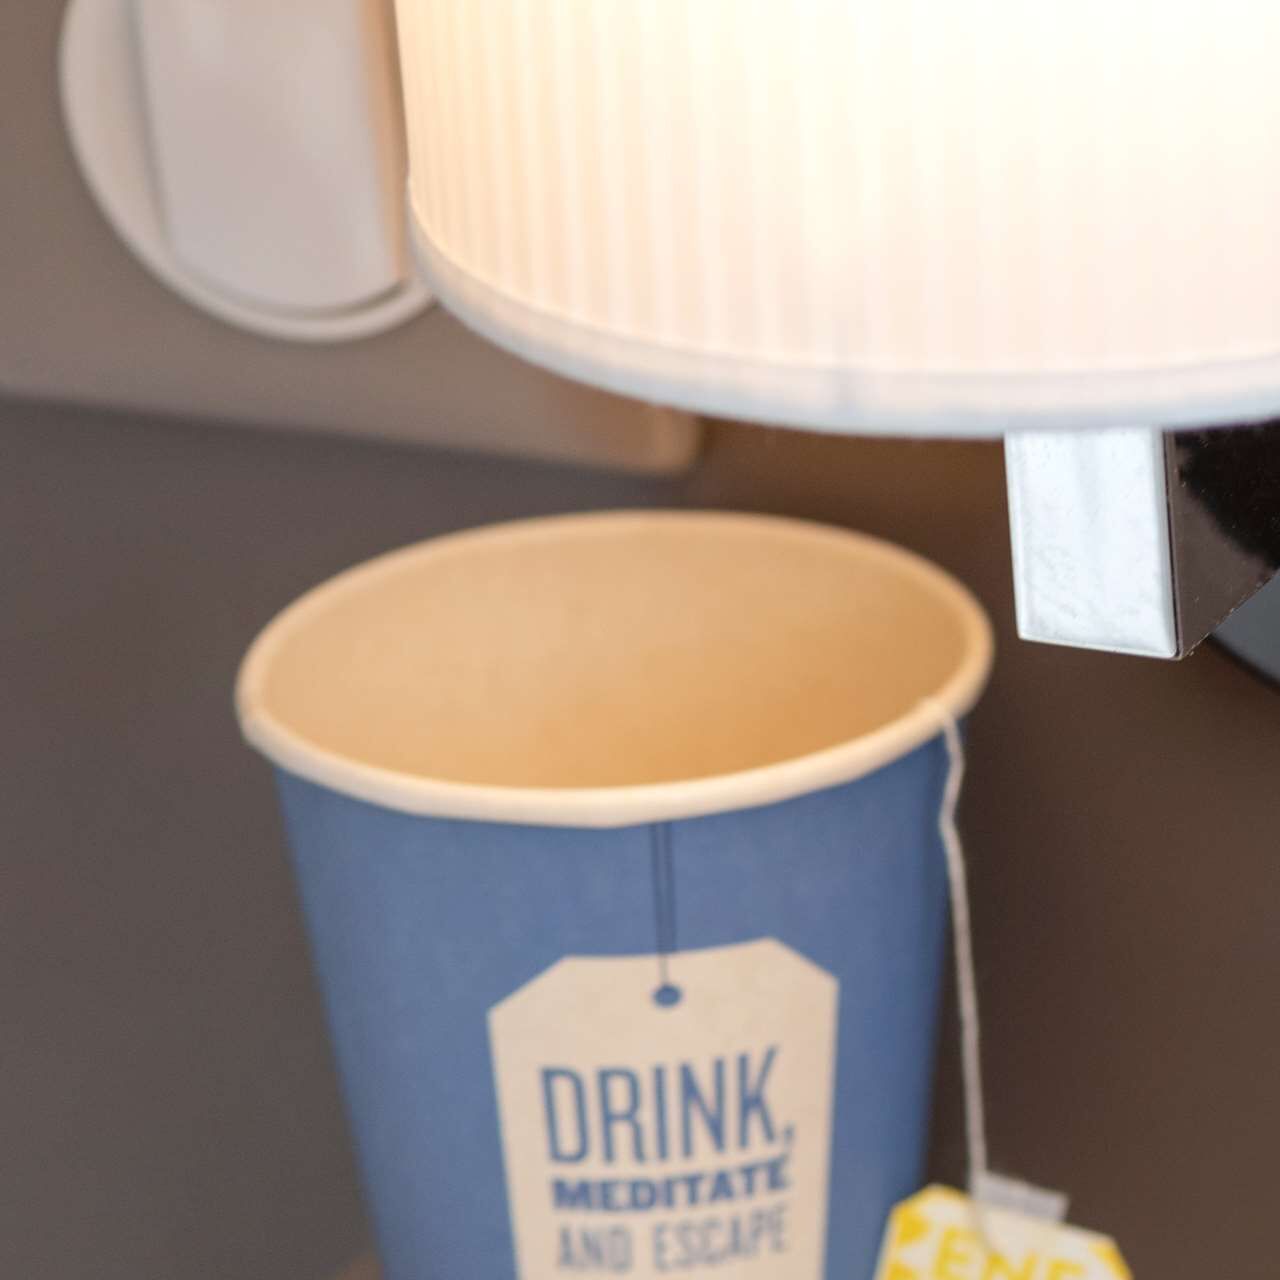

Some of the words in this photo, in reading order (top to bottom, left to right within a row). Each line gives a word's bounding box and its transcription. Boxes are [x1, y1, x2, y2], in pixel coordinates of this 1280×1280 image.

[540, 1046, 796, 1165] DRINK,
[551, 1153, 792, 1213] MEDITATE
[555, 1222, 635, 1275] AND
[652, 1205, 788, 1272] ESCAPE
